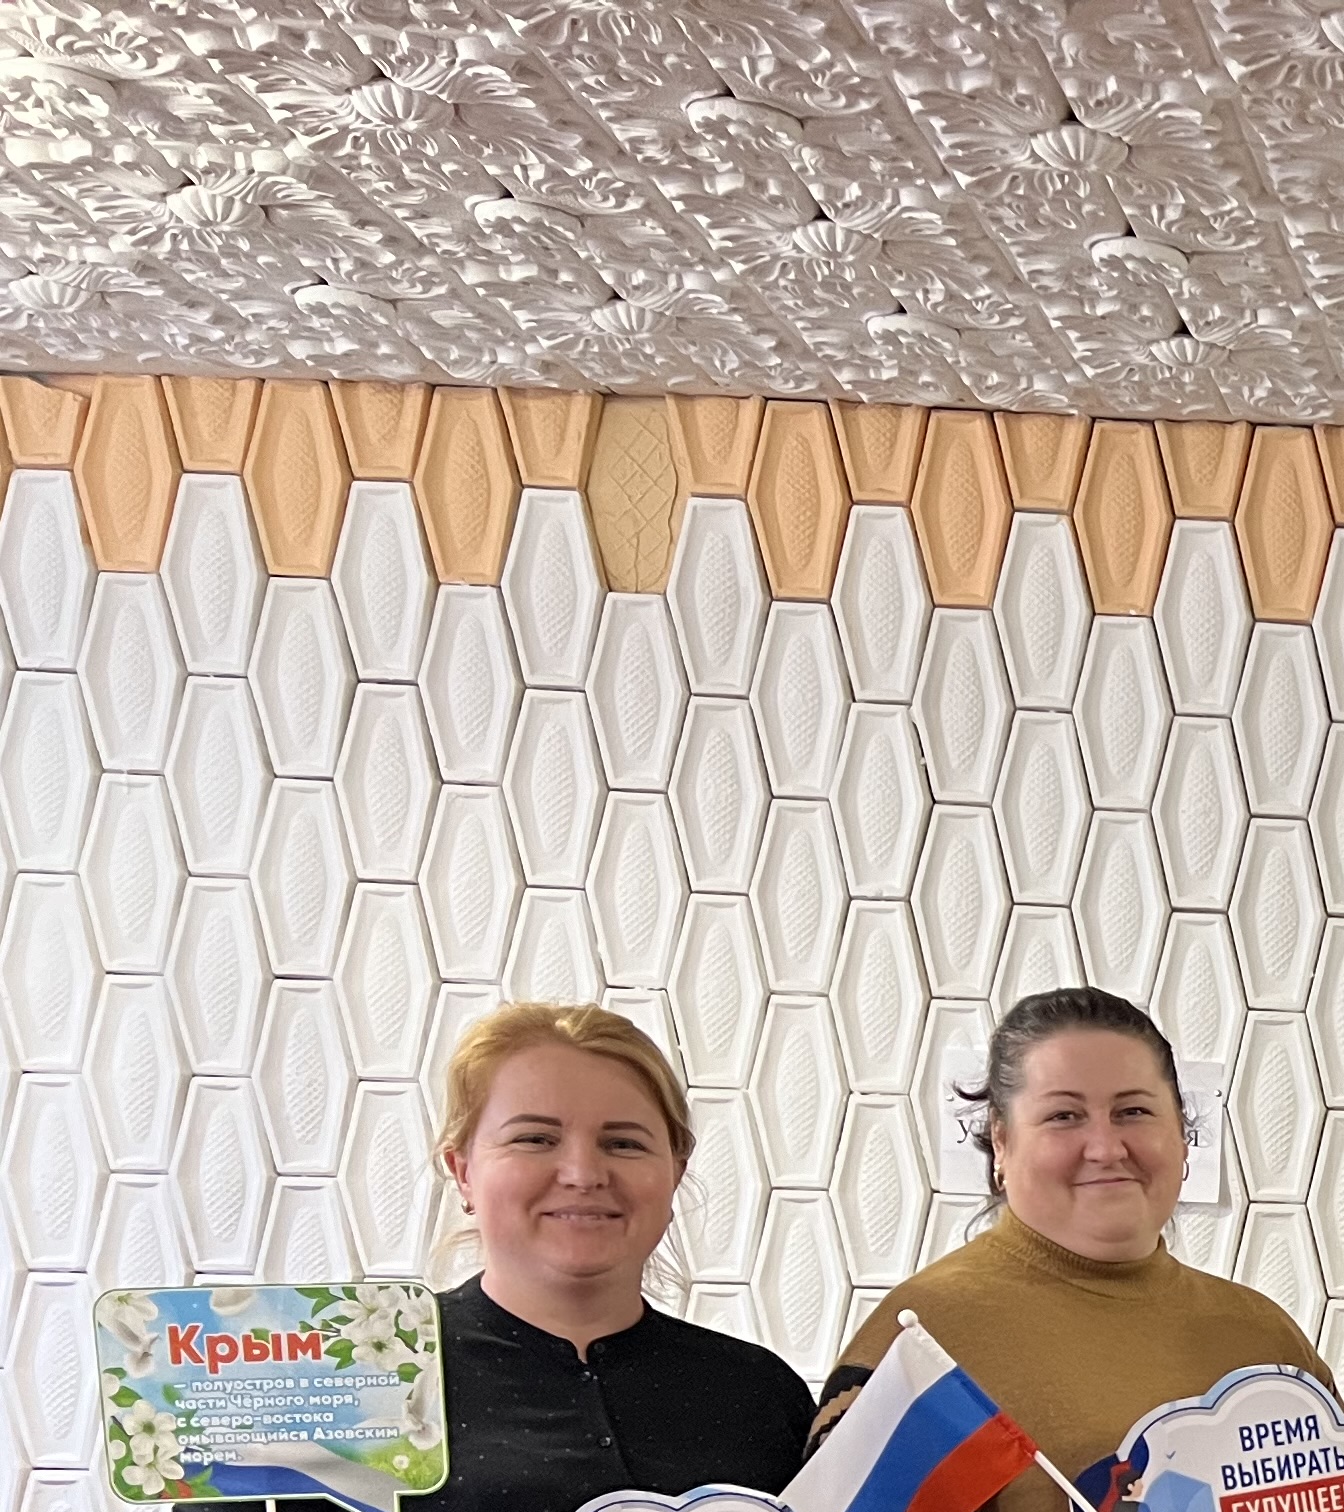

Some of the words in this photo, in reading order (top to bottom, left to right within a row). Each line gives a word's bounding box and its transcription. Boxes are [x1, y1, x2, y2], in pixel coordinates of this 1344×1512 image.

[167, 1324, 323, 1374] Крым
[191, 1378, 295, 1393] полуостров
[300, 1378, 309, 1388] в
[313, 1372, 400, 1389] северной
[174, 1399, 226, 1409] части
[230, 1394, 305, 1410] Чёрного
[309, 1394, 359, 1407] моря,
[176, 1417, 187, 1427] с
[190, 1412, 334, 1429] северо-востока
[178, 1428, 309, 1445] омывающийся
[313, 1427, 398, 1440] Азовским
[1238, 1414, 1321, 1452] ВРЕМЯ
[180, 1451, 242, 1466] морем.
